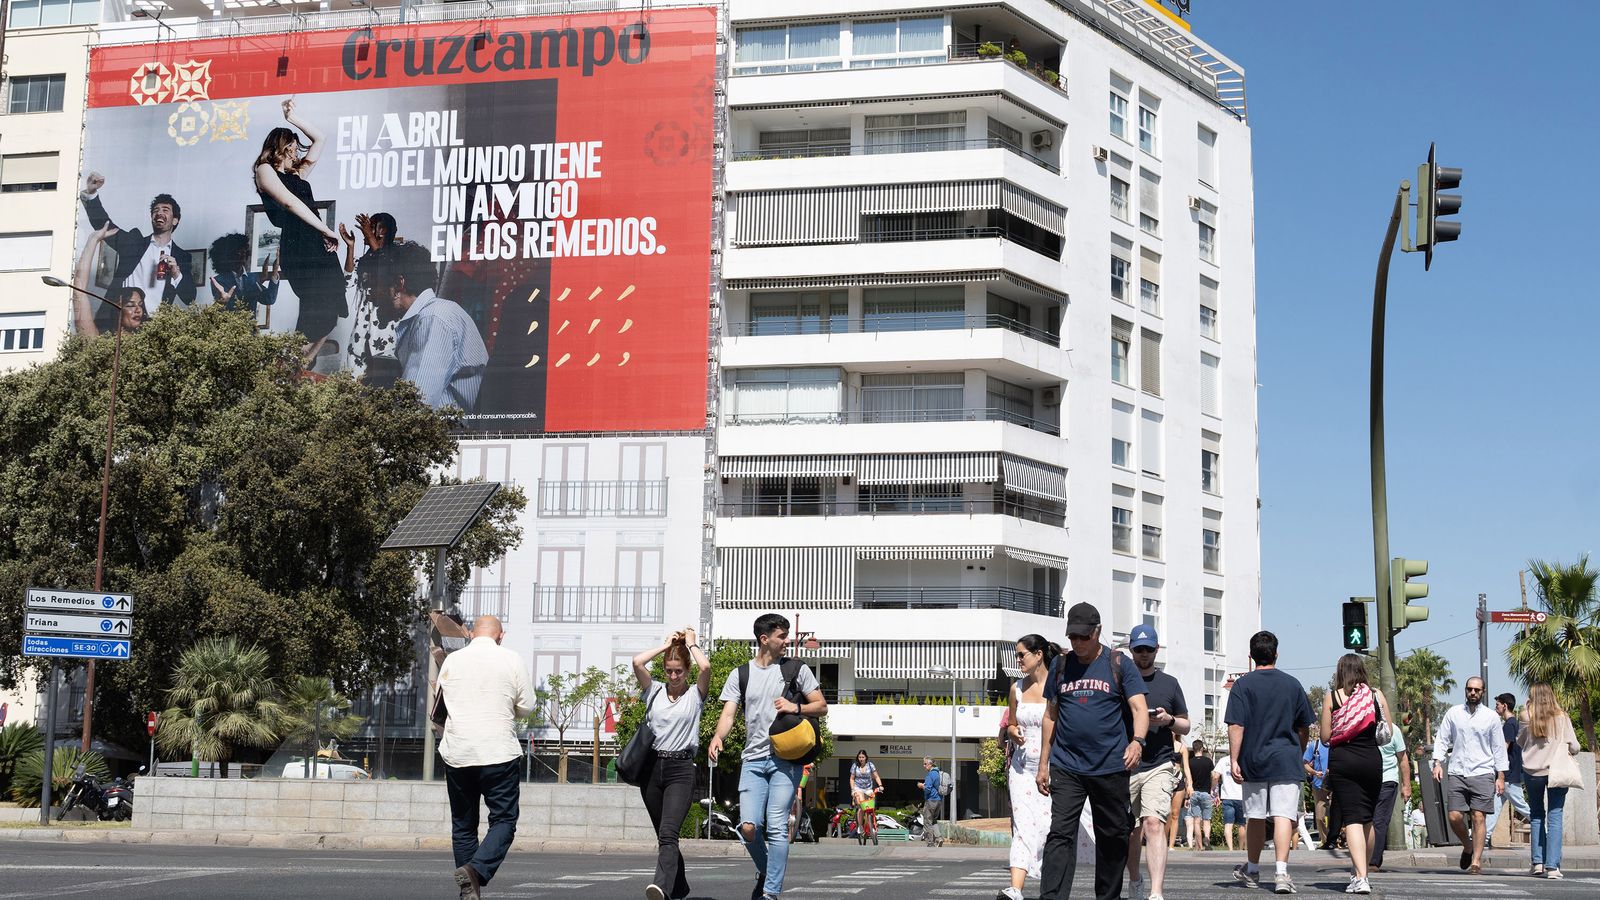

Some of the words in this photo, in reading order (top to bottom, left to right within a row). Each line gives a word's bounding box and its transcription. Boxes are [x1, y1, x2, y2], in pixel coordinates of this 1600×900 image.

[342, 22, 651, 80] Cruzcampo
[337, 115, 368, 152] EN
[372, 110, 464, 149] ABRIL
[337, 151, 399, 190] TODO
[401, 149, 430, 186] EL
[433, 144, 525, 185] MUNDO
[530, 141, 602, 181] TIENE
[432, 186, 466, 224] UN
[471, 180, 578, 222] AMIGO
[430, 224, 463, 262] EN
[470, 221, 517, 261] LOS
[523, 216, 667, 259] REMEDIOS.
[30, 594, 46, 602] Los
[51, 595, 95, 605] Remedios
[29, 618, 58, 627] Triana
[27, 645, 69, 653] direcciones
[1061, 679, 1110, 693] RAFTING
